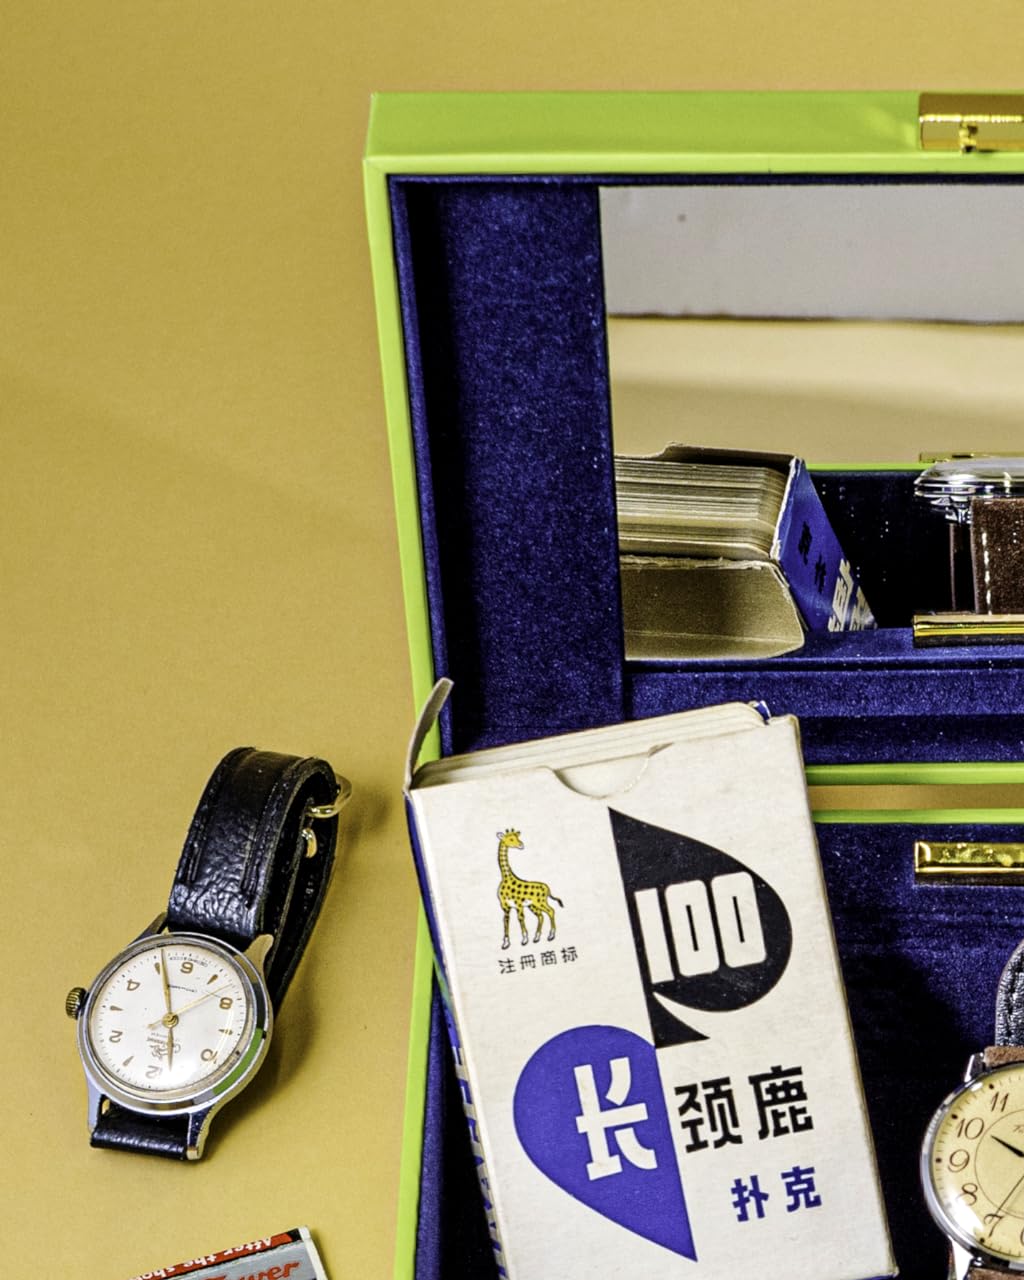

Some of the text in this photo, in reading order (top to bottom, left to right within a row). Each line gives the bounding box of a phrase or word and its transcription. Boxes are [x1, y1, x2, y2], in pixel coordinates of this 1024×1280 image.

[633, 870, 767, 985] 100
[990, 1092, 1009, 1113] 11
[956, 1117, 985, 1140] 10
[947, 1149, 971, 1173] 9
[729, 1165, 822, 1223] 扑克
